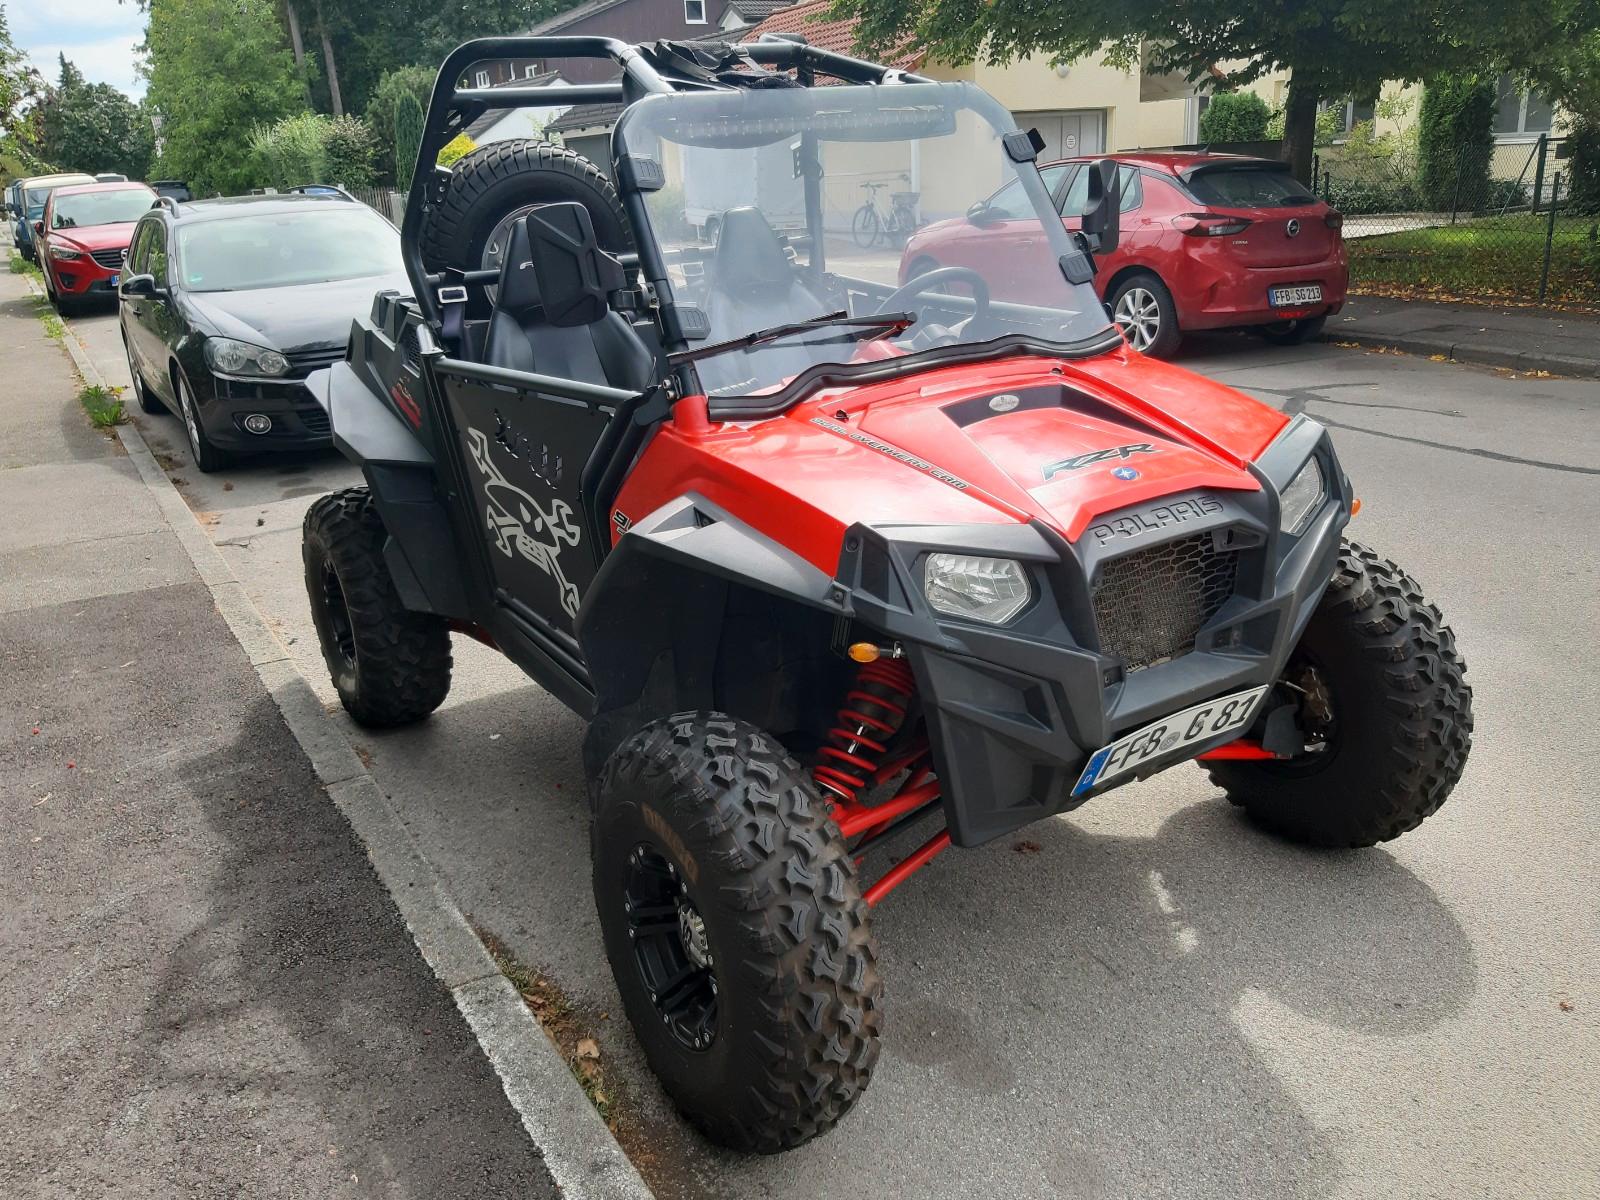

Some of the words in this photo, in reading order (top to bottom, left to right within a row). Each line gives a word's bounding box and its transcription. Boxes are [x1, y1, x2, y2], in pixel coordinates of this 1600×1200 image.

[1274, 289, 1291, 304] FFB
[1295, 288, 1306, 300] SG
[1307, 287, 1321, 300] 213
[850, 432, 930, 471] OVERHEAD
[931, 467, 968, 489] CAM
[1041, 443, 1162, 481] RZR
[612, 508, 632, 530] 9
[1087, 495, 1224, 547] POLARIS
[1098, 724, 1168, 780] FFB
[1183, 707, 1214, 741] G
[1211, 694, 1260, 732] 81
